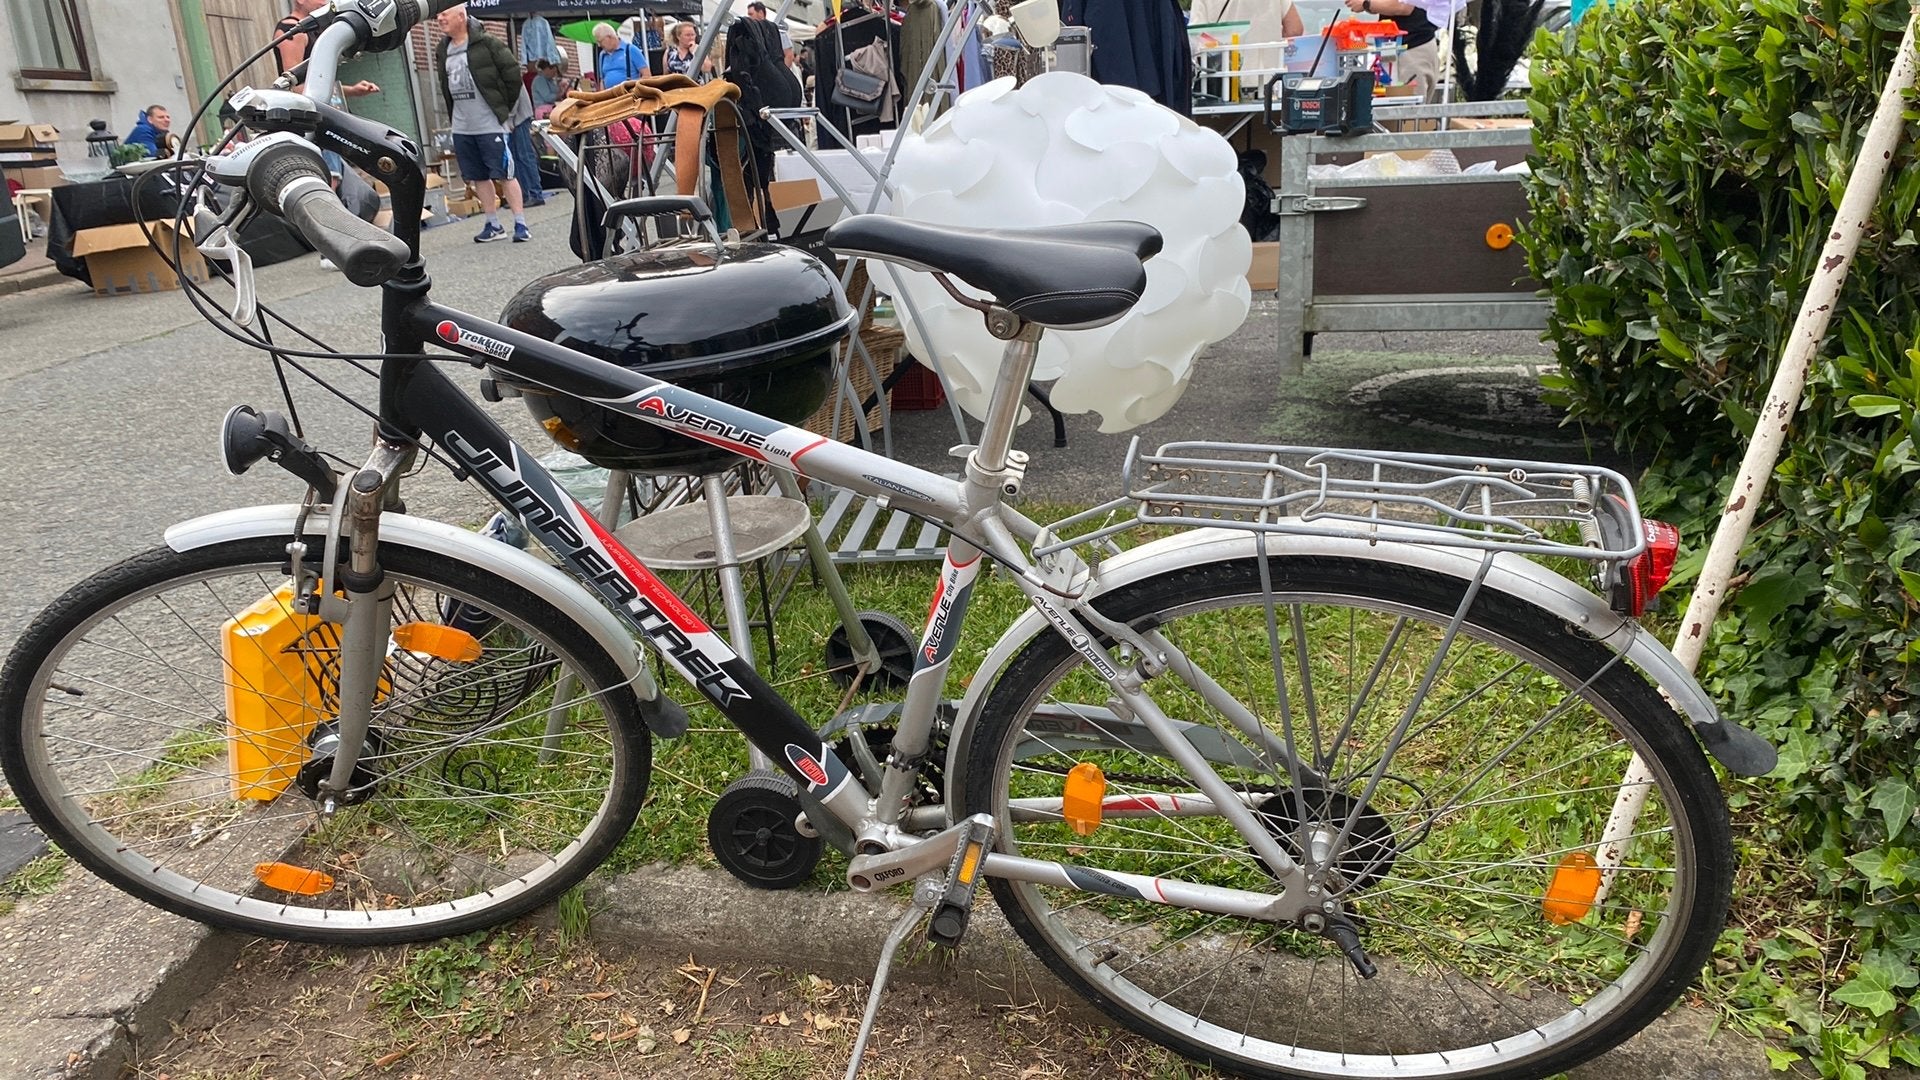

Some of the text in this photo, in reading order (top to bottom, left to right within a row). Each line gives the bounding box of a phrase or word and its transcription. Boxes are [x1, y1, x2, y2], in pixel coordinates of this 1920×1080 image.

[1301, 101, 1320, 109] BOSCH
[231, 136, 272, 161] SHIMANO
[325, 130, 371, 155] PROMAX
[460, 329, 512, 354] Trekking
[484, 346, 508, 359] Speed
[636, 396, 792, 459] AVENUE Light
[864, 475, 900, 492] ITALIAN
[445, 430, 751, 709] JUMPERTREK
[599, 536, 698, 629] JUMPERTREK TECHNOLOGY
[924, 568, 959, 664] AVENUE City Bike
[1034, 595, 1078, 637] AVENUE
[874, 867, 905, 881] OXFORD
